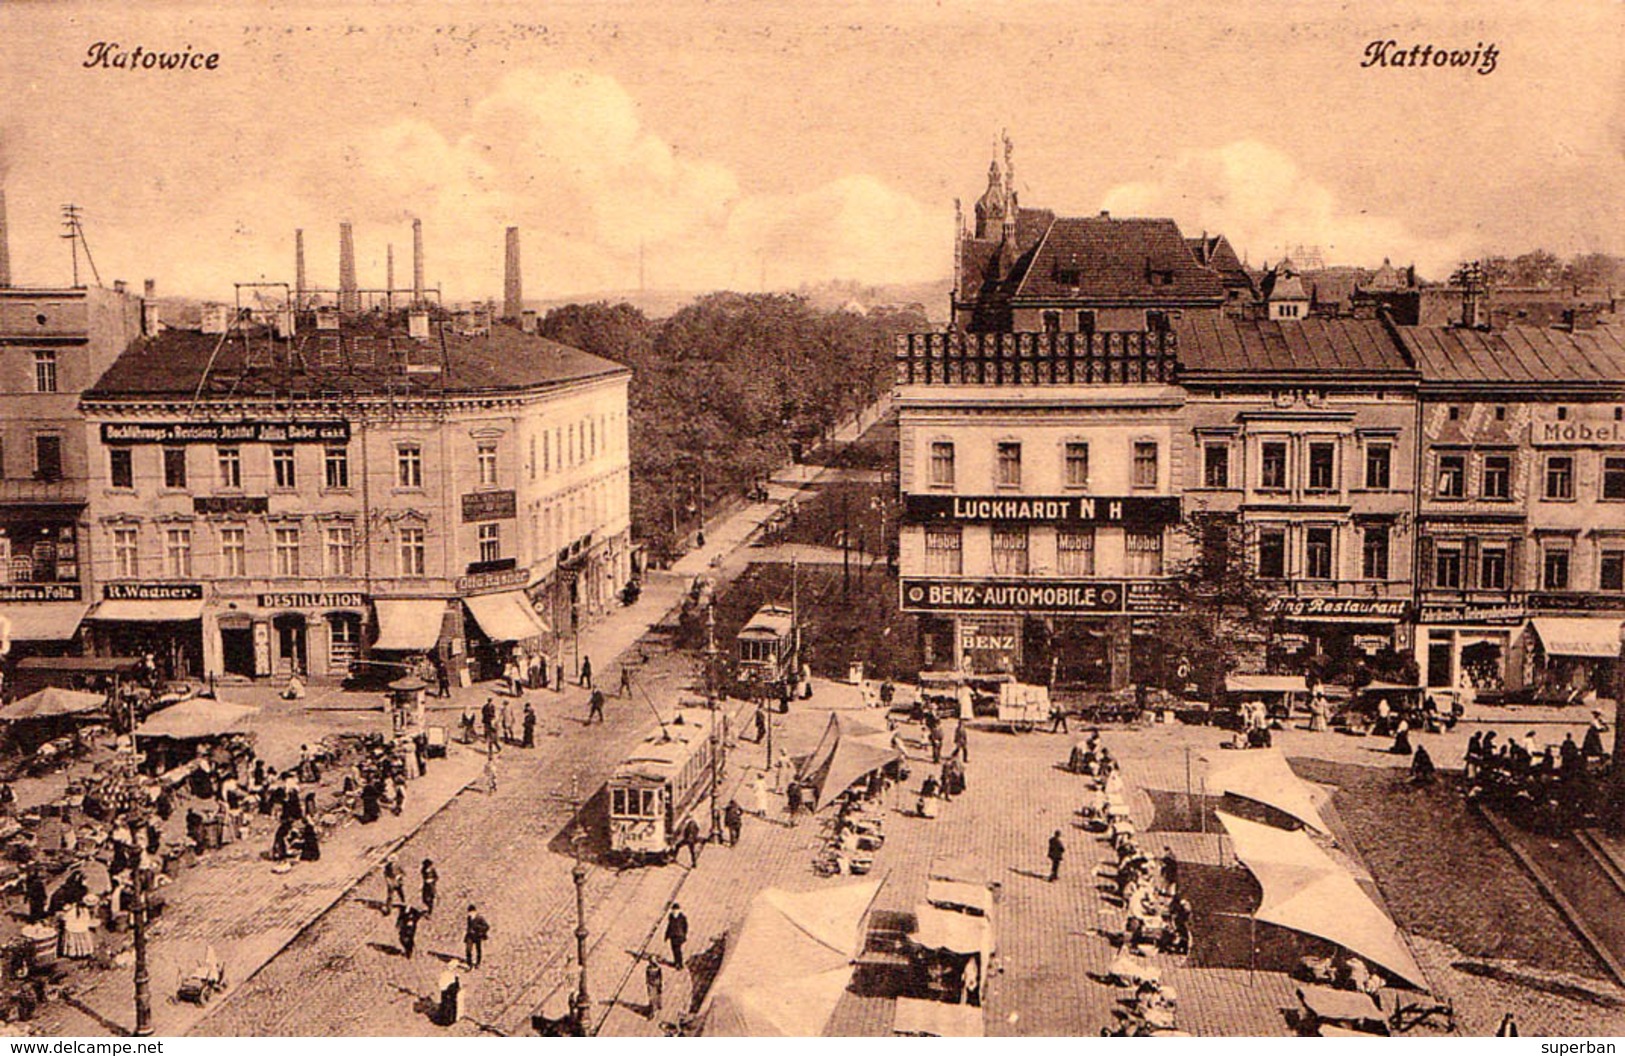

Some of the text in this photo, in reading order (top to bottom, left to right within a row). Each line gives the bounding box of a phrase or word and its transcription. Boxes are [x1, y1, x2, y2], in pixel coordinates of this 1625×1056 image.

[954, 497, 1071, 519] LUCKHARDT
[263, 594, 362, 608] DESTILLATION
[963, 636, 1015, 649] BENZ
